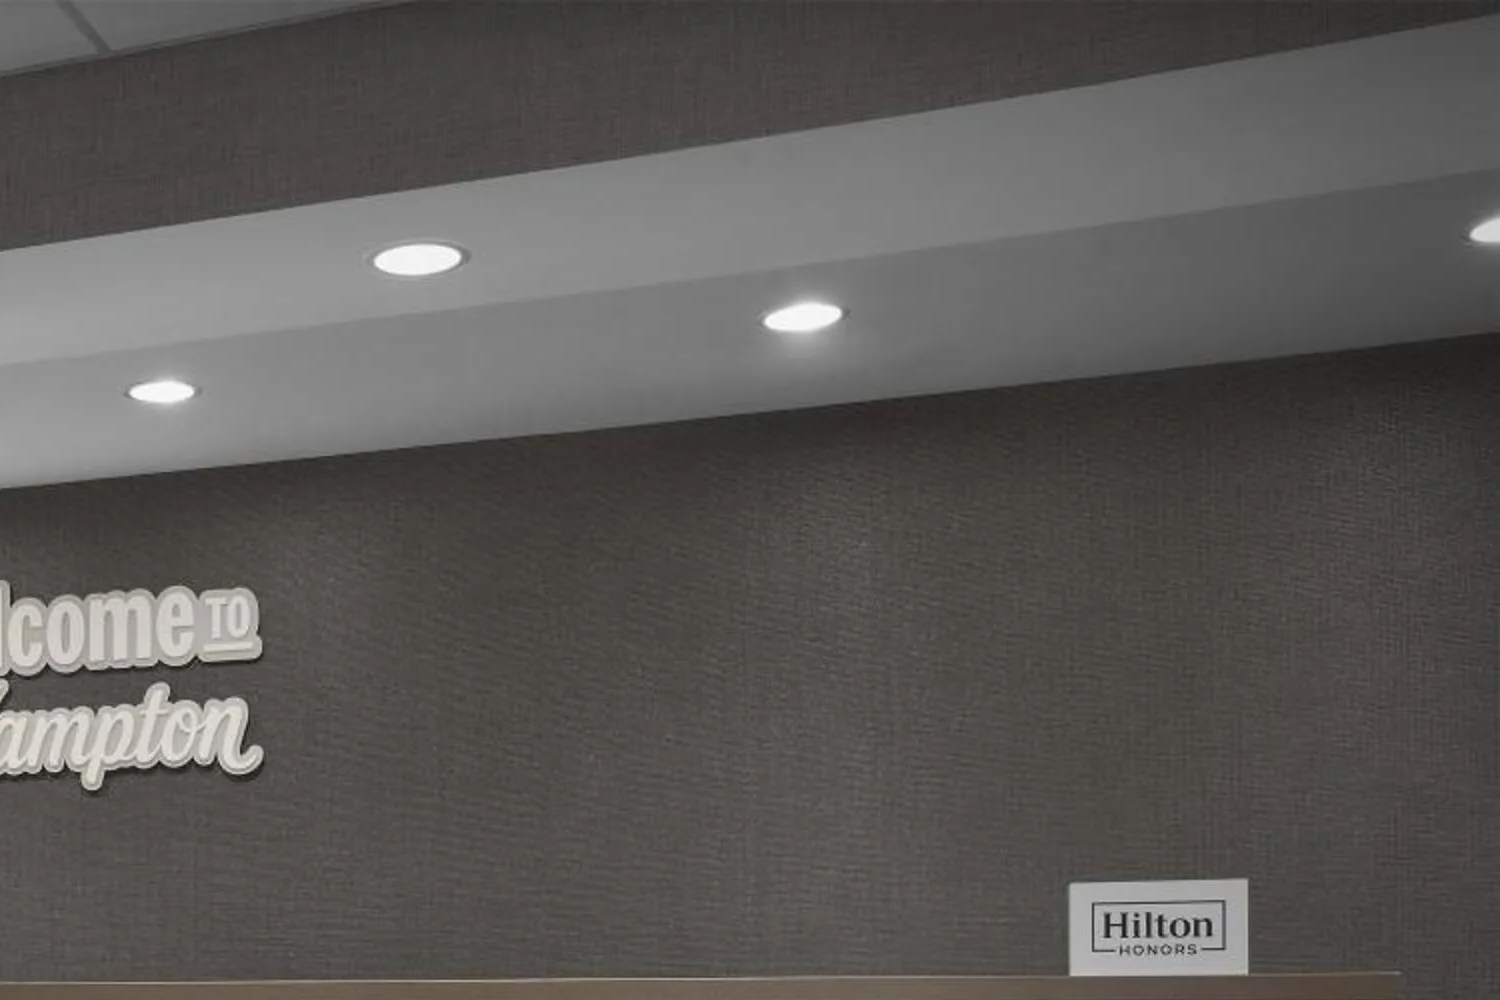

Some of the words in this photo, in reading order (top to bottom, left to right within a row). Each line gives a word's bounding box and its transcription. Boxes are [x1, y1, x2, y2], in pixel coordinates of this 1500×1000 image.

[202, 591, 254, 650] TO
[1102, 911, 1213, 938] Hilton
[1119, 944, 1197, 956] HONORS
